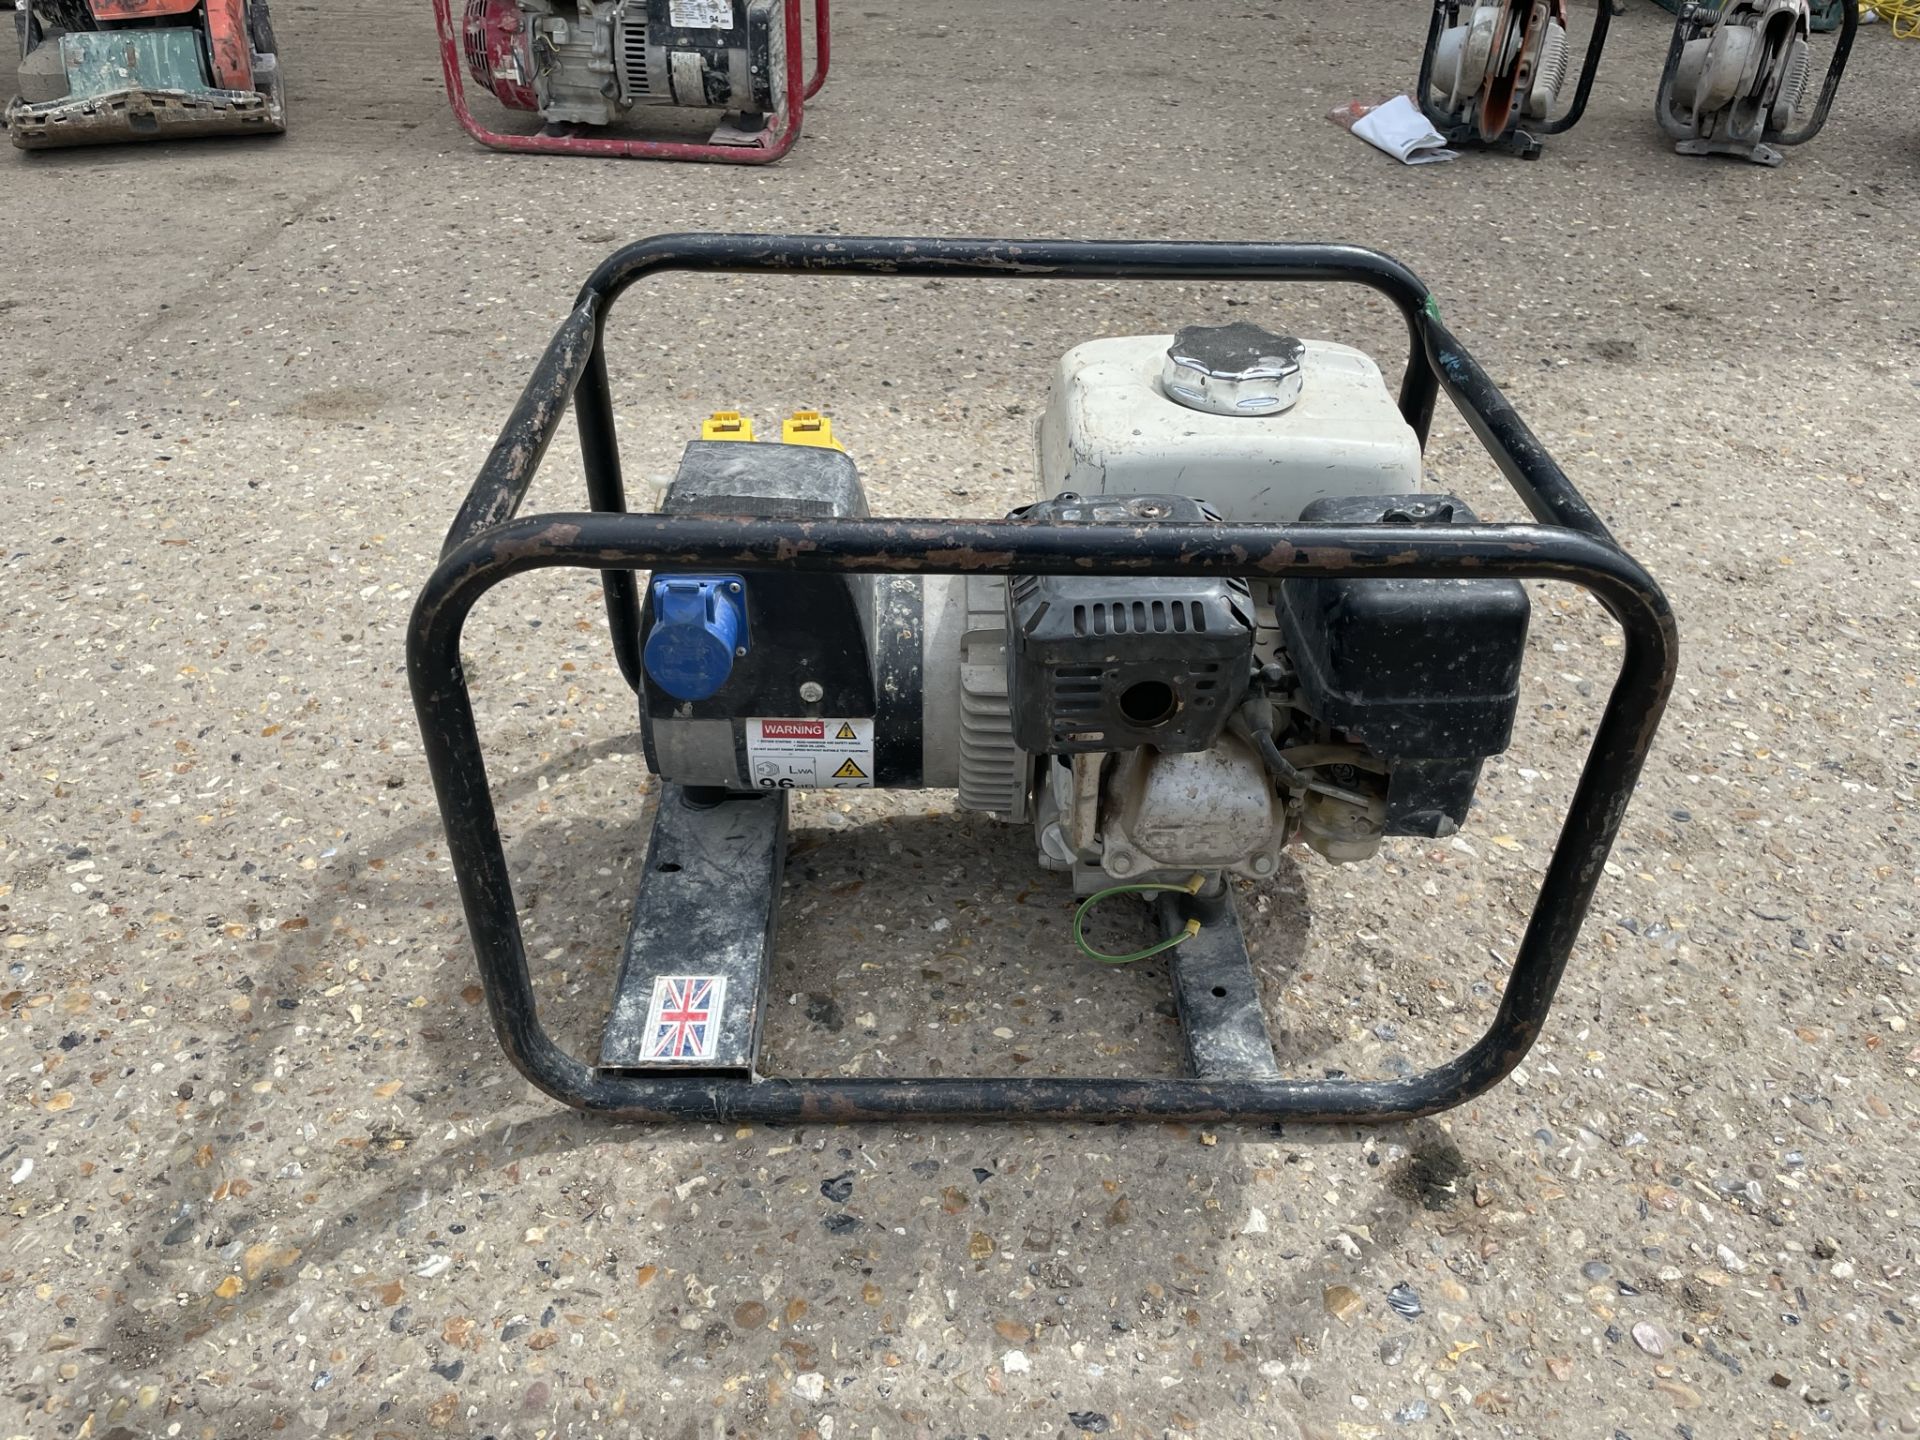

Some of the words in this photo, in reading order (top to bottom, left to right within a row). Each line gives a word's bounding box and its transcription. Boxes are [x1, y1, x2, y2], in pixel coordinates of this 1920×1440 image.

[709, 15, 719, 23] 94
[764, 725, 822, 735] WARNING
[759, 777, 795, 788] 96
